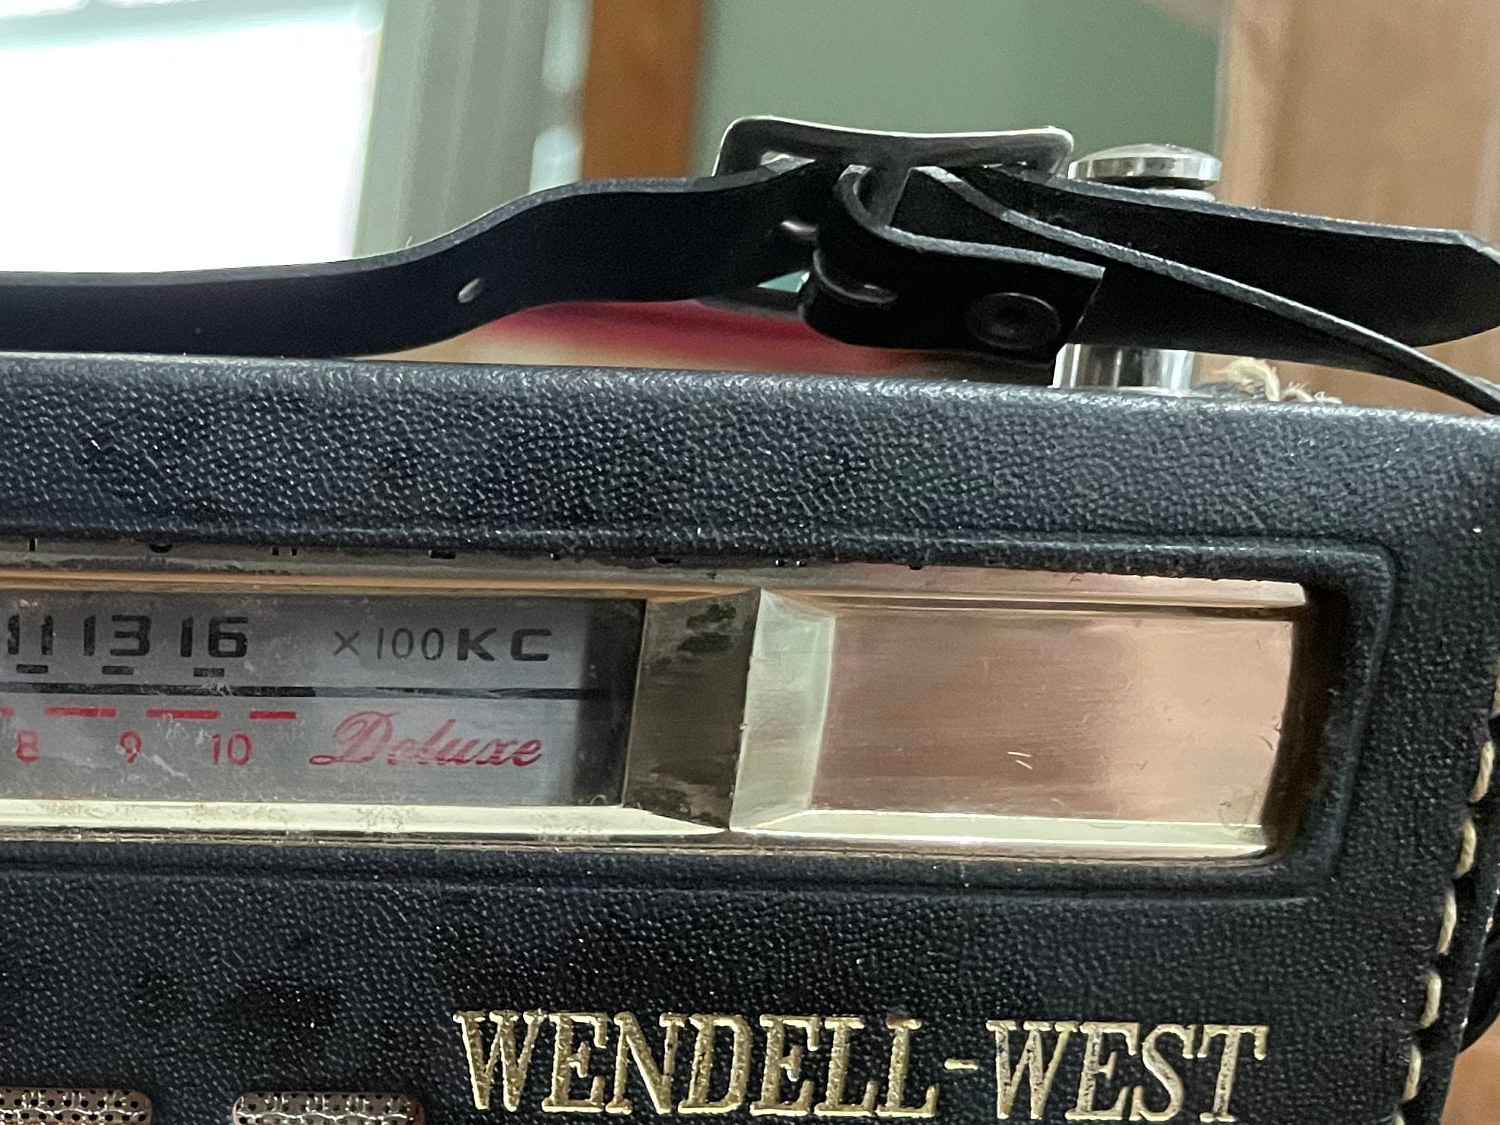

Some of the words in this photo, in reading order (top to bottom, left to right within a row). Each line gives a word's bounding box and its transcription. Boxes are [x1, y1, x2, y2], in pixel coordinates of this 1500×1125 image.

[7, 613, 54, 657] 11
[82, 614, 151, 658] 13
[179, 616, 248, 660] 16
[14, 730, 41, 764] 8
[118, 729, 143, 765] 9
[211, 732, 253, 766] 10
[308, 710, 544, 768] Deluxe
[452, 1009, 1270, 1123] WENDELL-WEST
